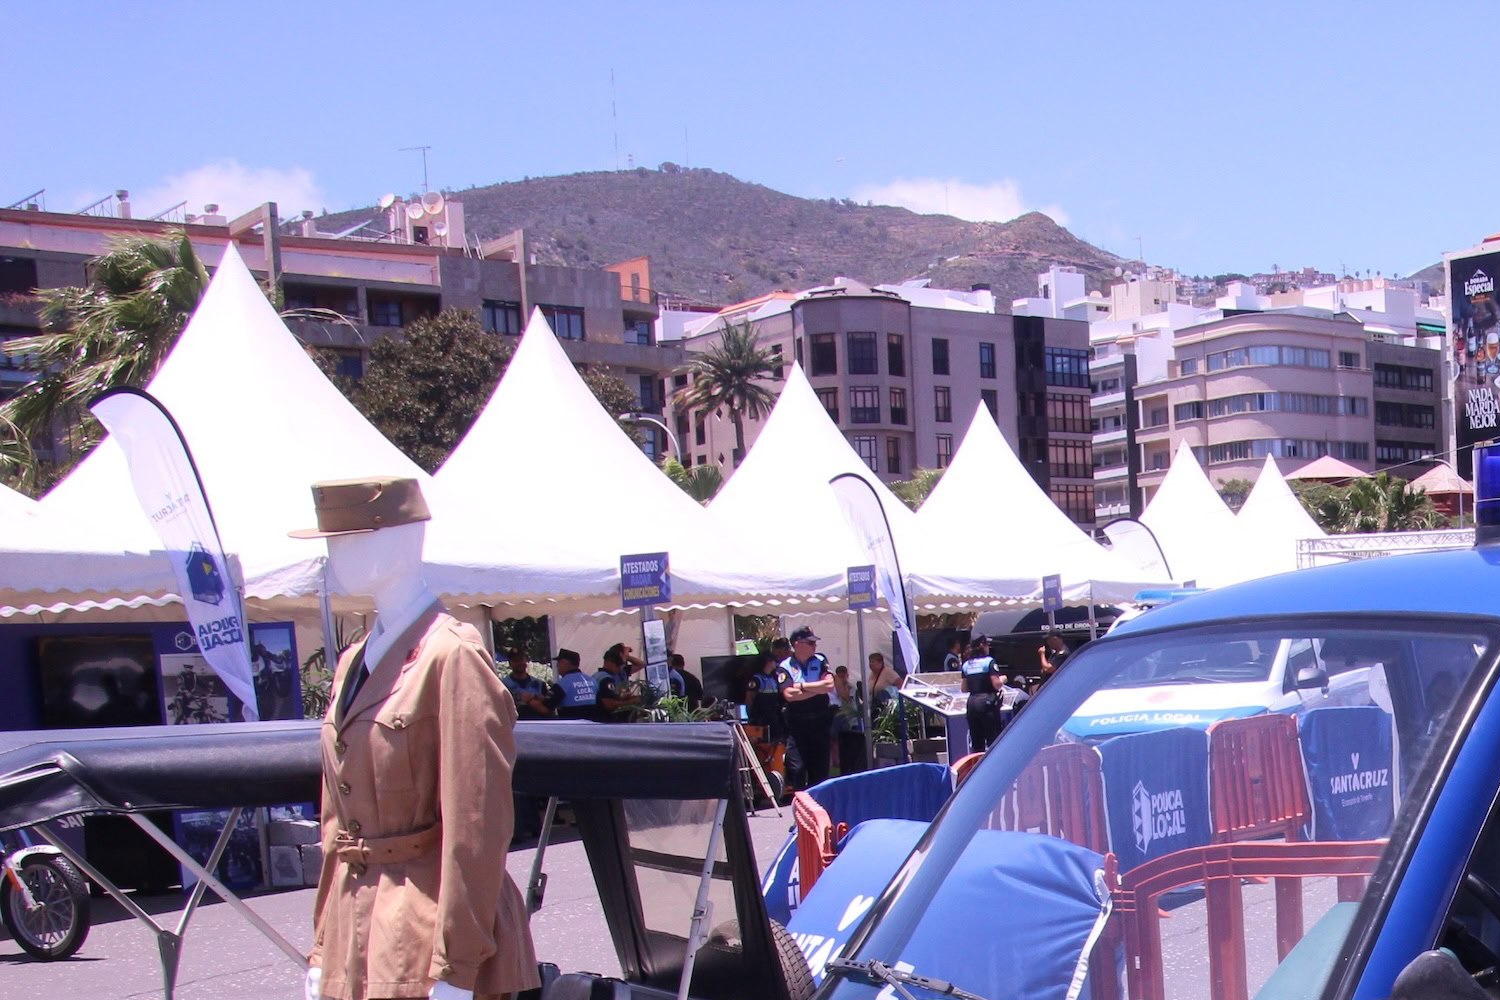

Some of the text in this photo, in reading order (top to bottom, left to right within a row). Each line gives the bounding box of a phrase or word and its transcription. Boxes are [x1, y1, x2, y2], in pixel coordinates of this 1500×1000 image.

[1464, 277, 1494, 297] Especial
[1468, 387, 1494, 401] NADA
[1465, 399, 1500, 417] MARIDA
[622, 560, 659, 575] ATESTADOS
[1074, 621, 1099, 629] DRONS
[1090, 713, 1201, 727] POLICIA LOCAL
[1330, 768, 1389, 795] SANTACRUZ
